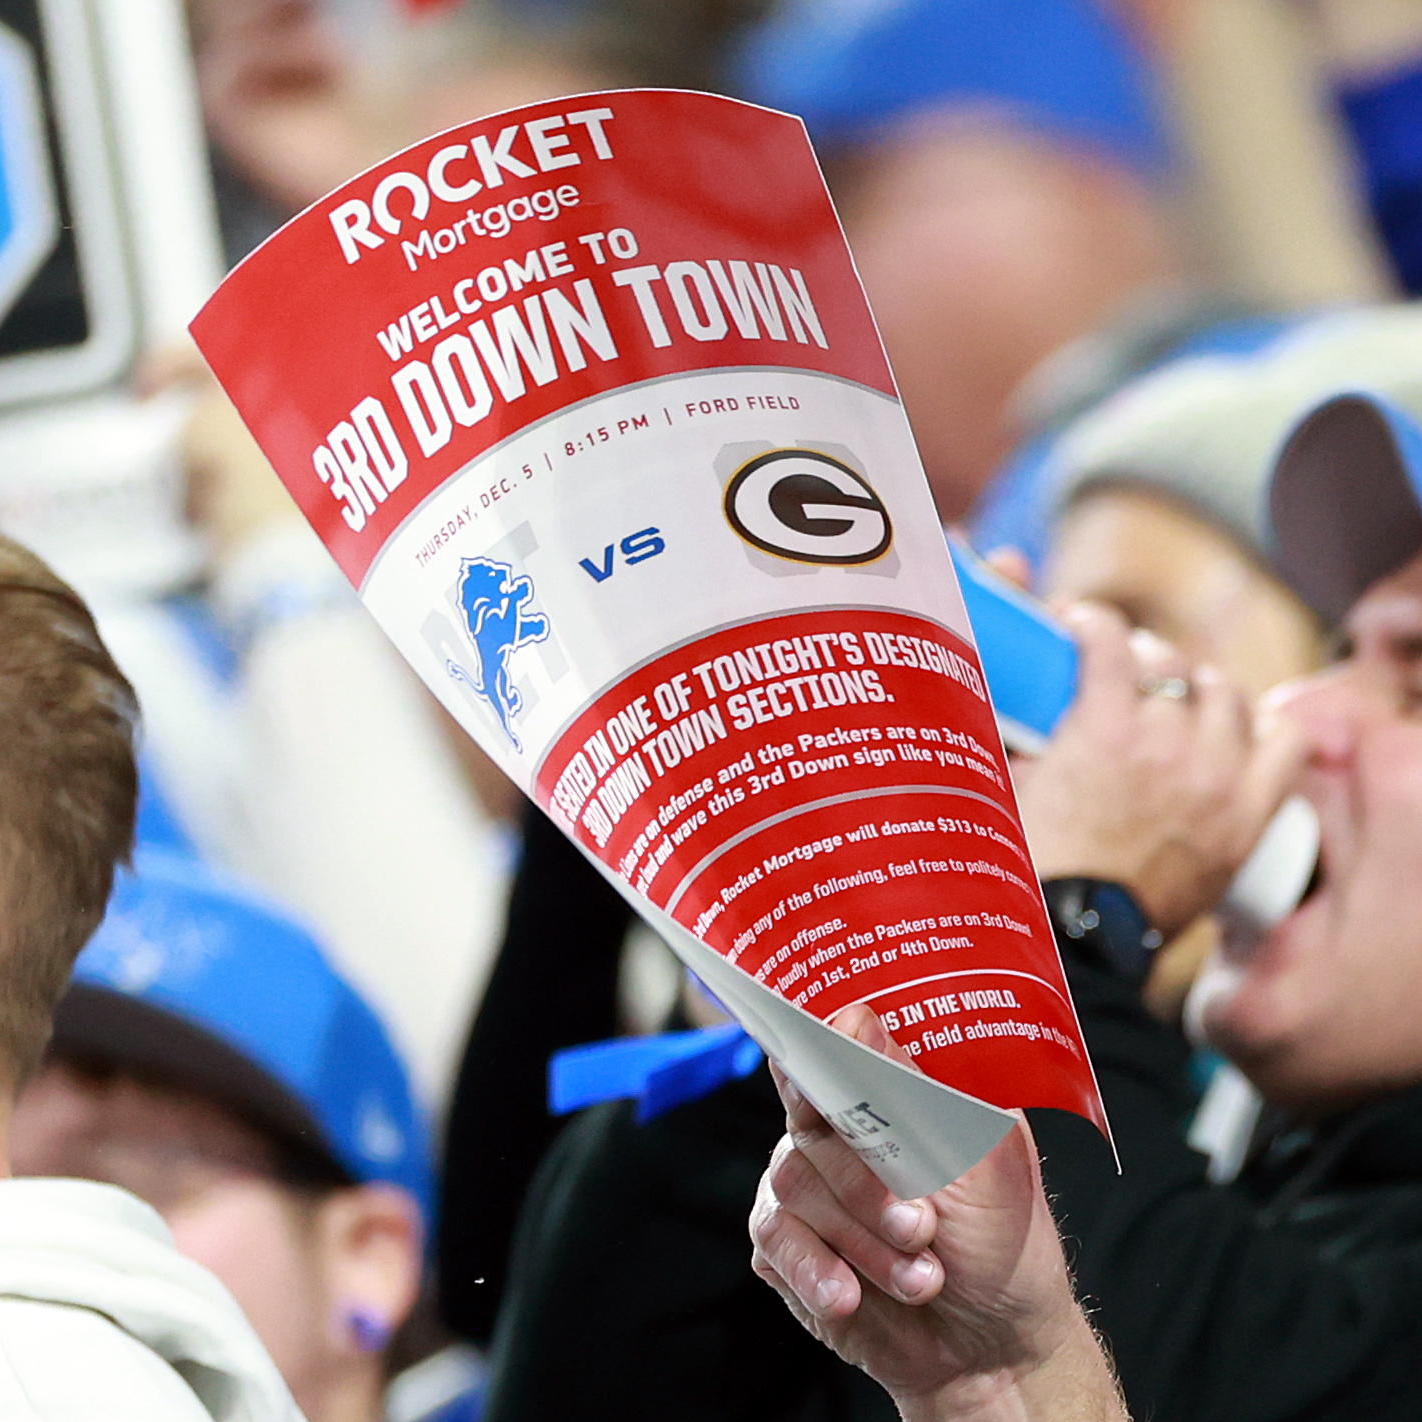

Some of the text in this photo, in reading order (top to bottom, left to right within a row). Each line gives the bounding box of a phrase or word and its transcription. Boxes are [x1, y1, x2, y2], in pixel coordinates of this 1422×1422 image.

[329, 107, 615, 265] ROCKET
[400, 184, 580, 272] Mortgage
[376, 227, 639, 362] WELCOME TO
[312, 396, 409, 533] 3RD
[390, 277, 619, 459] DOWN
[611, 259, 830, 350] TOWN
[415, 395, 801, 568] THURSDAY, DEC. 5 8:15 PM FORD FIELD
[578, 526, 666, 583] VS
[583, 729, 616, 778] IN
[606, 695, 658, 756] ONE
[653, 672, 693, 722] OF
[692, 631, 866, 700] TONIGHT'S
[862, 631, 988, 703] DESIGNATED
[726, 668, 896, 731] SECTIONS.
[641, 703, 728, 778] TOWN
[581, 798, 615, 849] 3RD
[596, 751, 653, 825] DOWN
[633, 833, 650, 857] are
[645, 819, 662, 841] on
[658, 777, 715, 827] defense
[717, 751, 755, 785] and
[757, 743, 795, 766] the
[797, 726, 883, 752] Packers
[885, 726, 917, 741] are
[919, 727, 942, 742] on
[942, 727, 969, 750] 3rd
[654, 833, 675, 866] and
[670, 809, 708, 846] wave
[707, 786, 746, 817] this
[746, 765, 786, 795] 3rd
[787, 753, 850, 780] Down
[852, 746, 897, 767] sign
[896, 743, 933, 762] like
[934, 749, 965, 767] you
[965, 756, 997, 784] mean
[719, 866, 764, 905] Rocket
[762, 834, 843, 875] Mortgage
[845, 822, 879, 843] will
[880, 818, 936, 836] donate
[936, 816, 973, 834] $313
[973, 824, 988, 837] to
[752, 912, 774, 936] any
[772, 899, 788, 921] of
[787, 890, 813, 912] the
[812, 868, 889, 901] following,
[888, 859, 919, 878] feel
[917, 858, 949, 874] free
[948, 857, 966, 872] to
[965, 859, 1007, 882] politely
[761, 955, 779, 976] are
[775, 944, 793, 963] on
[790, 917, 848, 951] offense.
[777, 961, 809, 992] loudly
[807, 941, 847, 969] when
[846, 930, 875, 950] the
[874, 917, 938, 942] Packers
[938, 913, 963, 928] are
[963, 913, 982, 927] on
[980, 911, 1004, 929] 3rd
[806, 979, 824, 997] on
[821, 965, 851, 988] 1st,
[849, 950, 881, 975] 2nd
[881, 947, 898, 964] or
[900, 938, 929, 958] 4th
[928, 935, 975, 953] Down.
[898, 1001, 927, 1028] IN
[923, 993, 962, 1019] THE
[958, 988, 1022, 1011] WORLD.
[921, 1022, 965, 1052] field
[964, 1018, 1042, 1042] advantage
[1039, 1021, 1054, 1042] in
